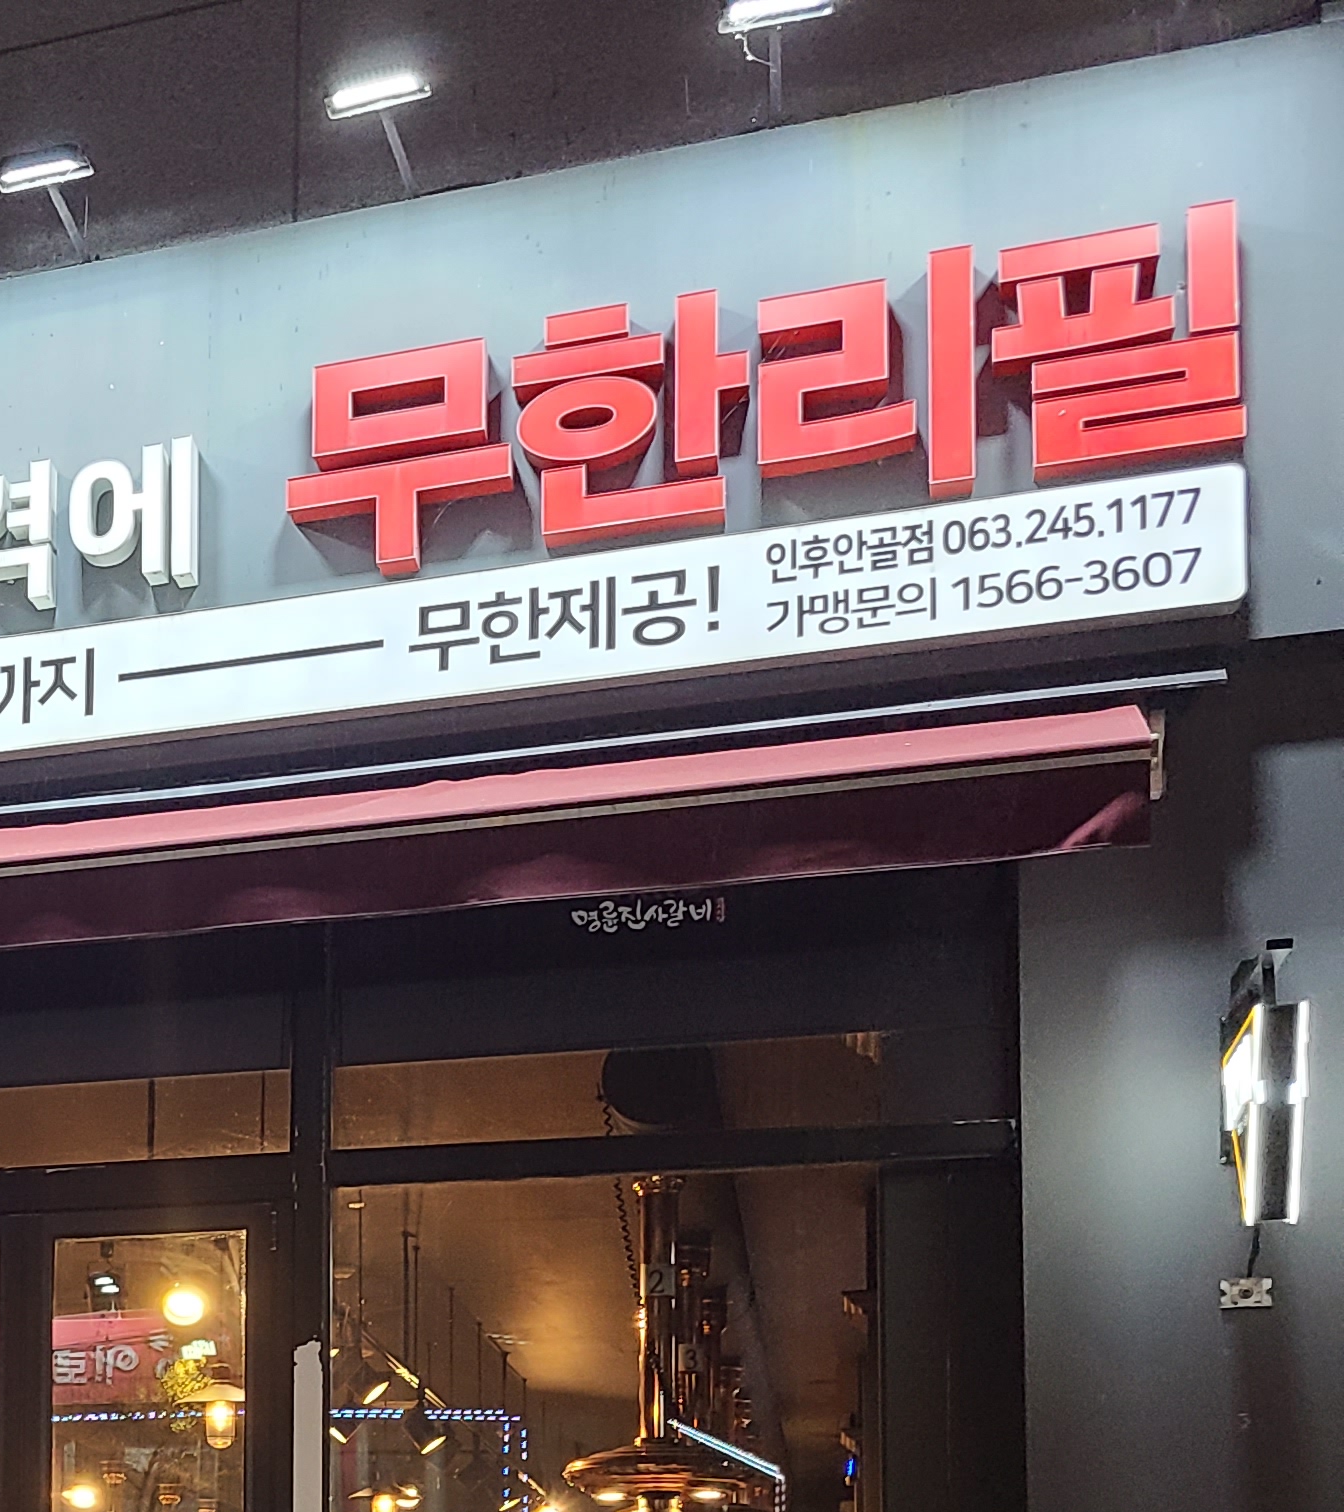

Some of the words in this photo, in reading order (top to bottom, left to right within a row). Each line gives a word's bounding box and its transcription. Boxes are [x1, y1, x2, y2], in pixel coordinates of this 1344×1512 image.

[285, 199, 1247, 577] 무한리필
[764, 520, 936, 586] 인후안골점
[941, 486, 1202, 558] 063.245.1177
[407, 564, 723, 673] 무한제공!
[765, 578, 938, 639] 가맹문의
[950, 548, 1203, 617] 1566-3607
[571, 898, 712, 933] 명륜진사갈비
